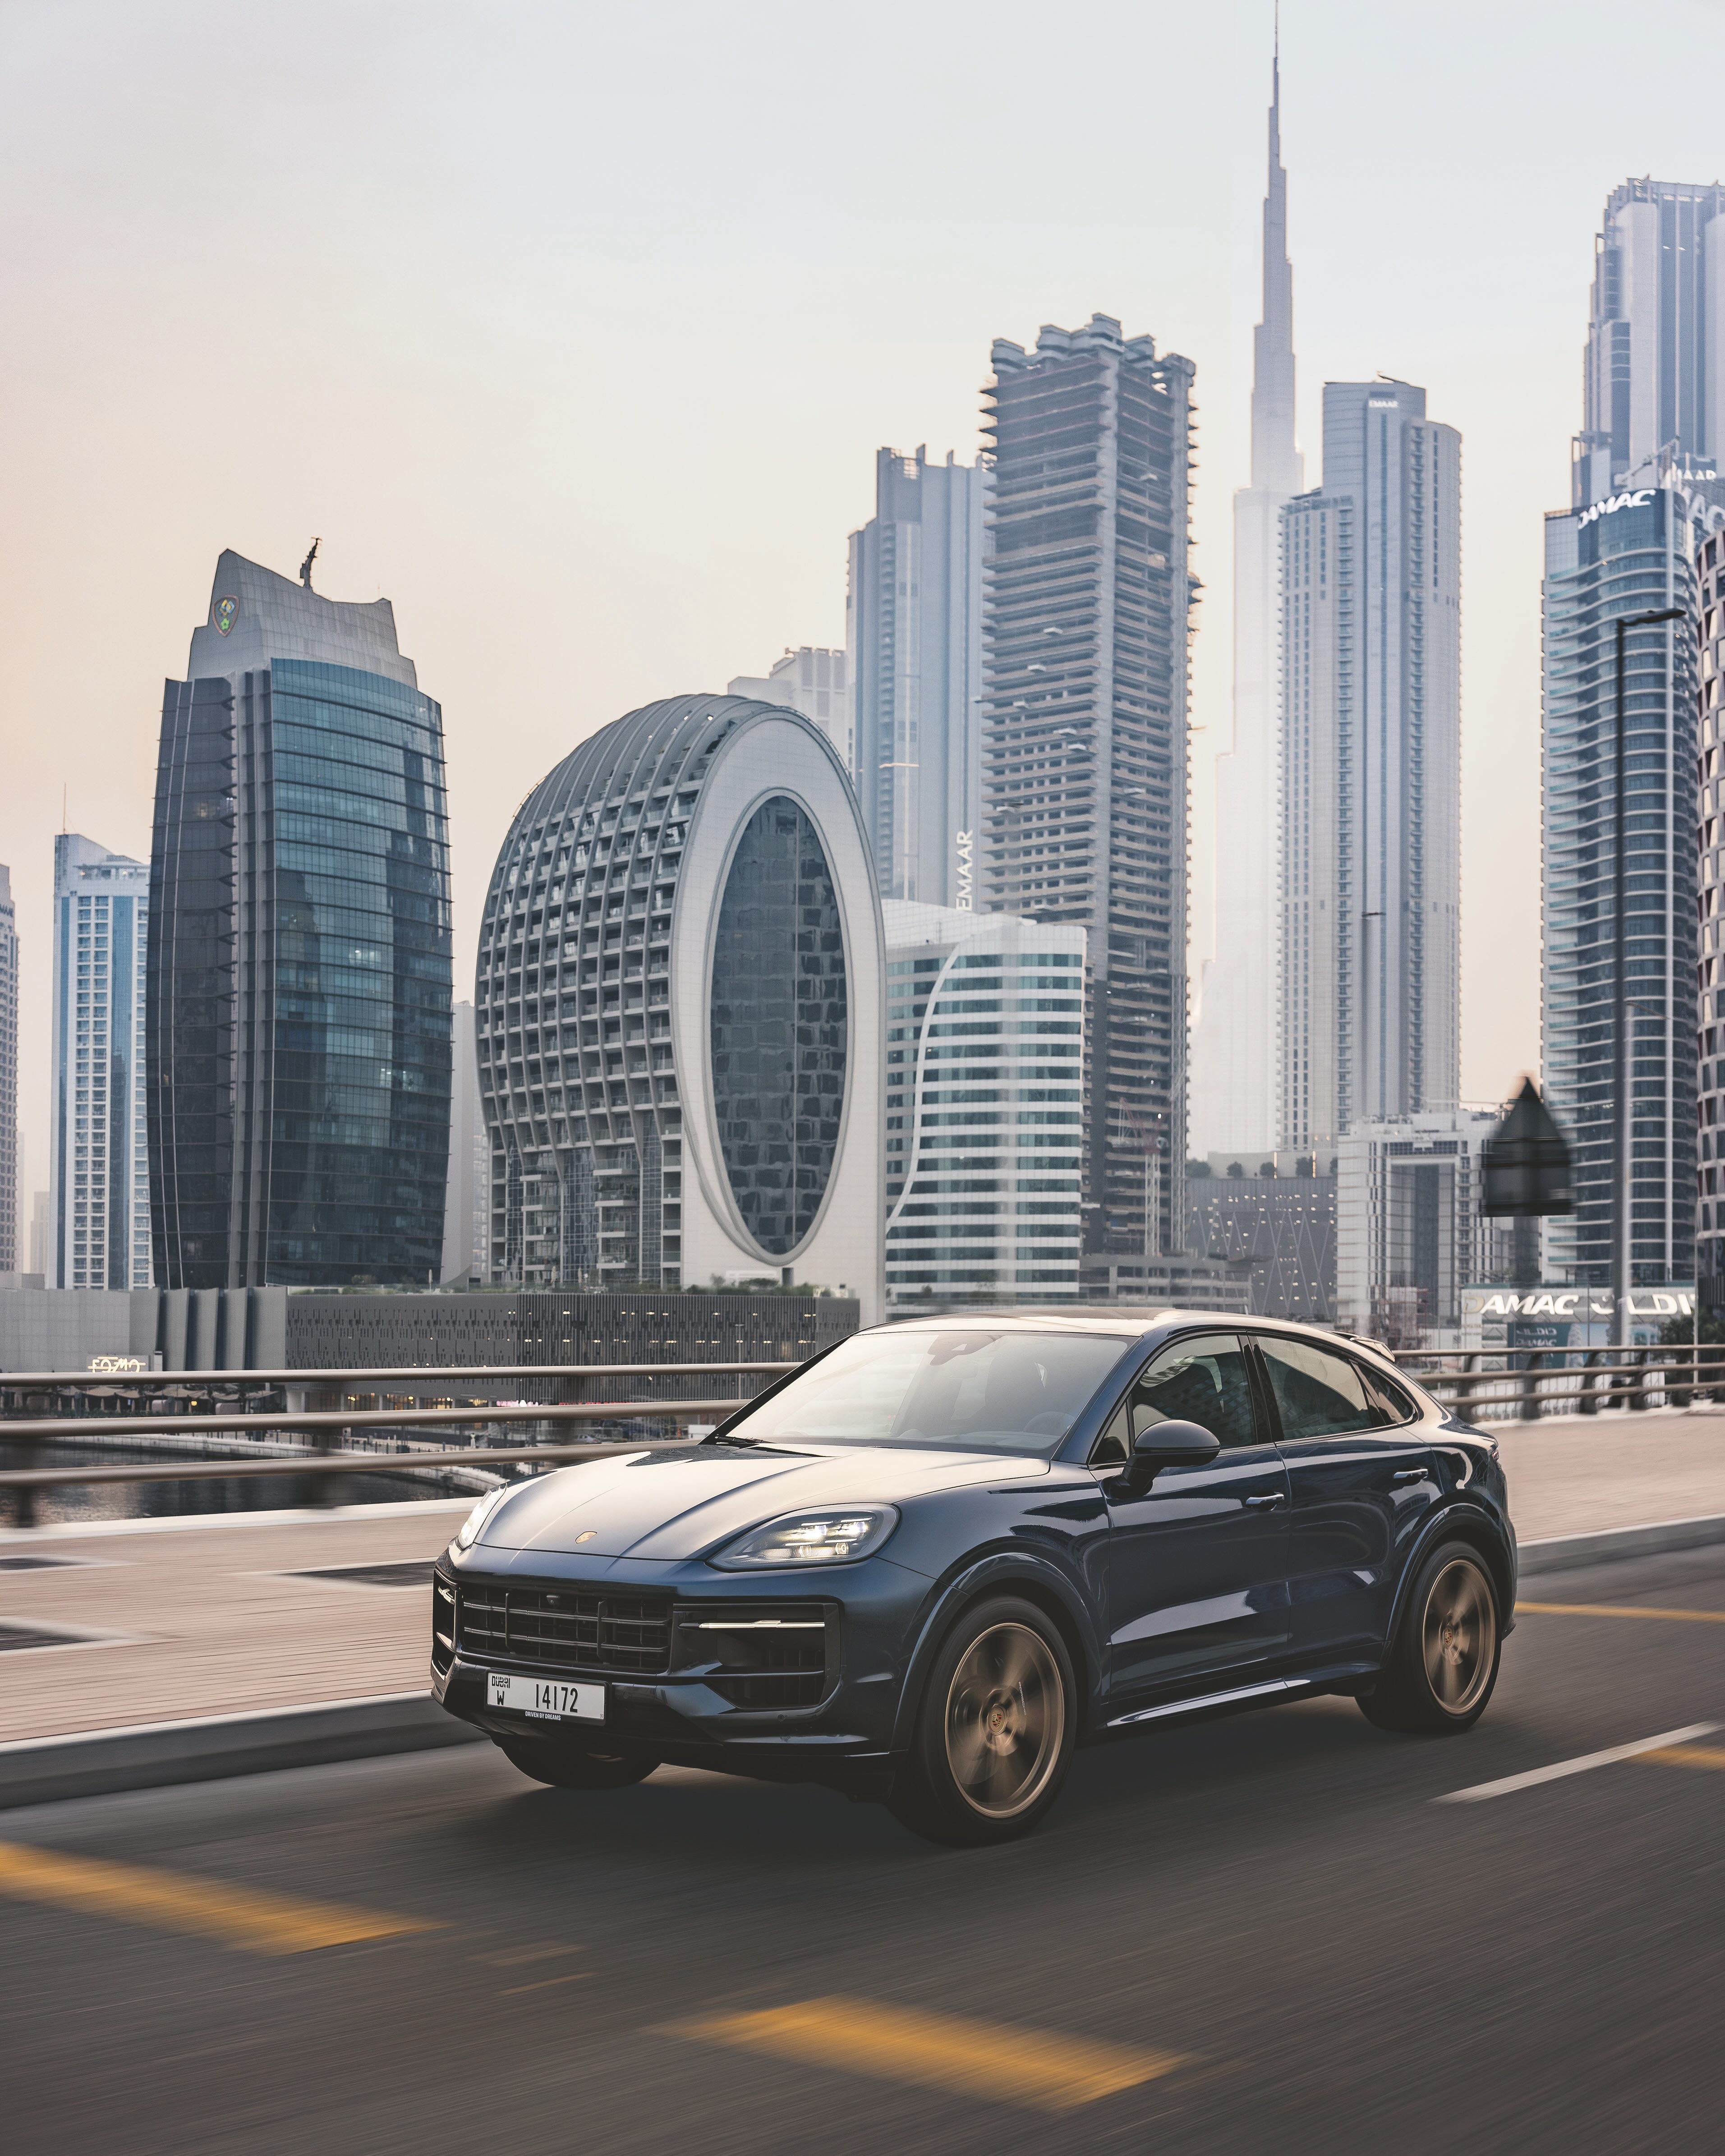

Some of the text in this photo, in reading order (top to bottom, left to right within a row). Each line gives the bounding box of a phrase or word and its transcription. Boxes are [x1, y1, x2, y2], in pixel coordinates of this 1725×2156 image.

[956, 830, 973, 911] EMAAR
[1463, 1294, 1579, 1315] DAMAC
[497, 1683, 579, 1713] W 14172
[1018, 1681, 1027, 1716] PORSCHE
